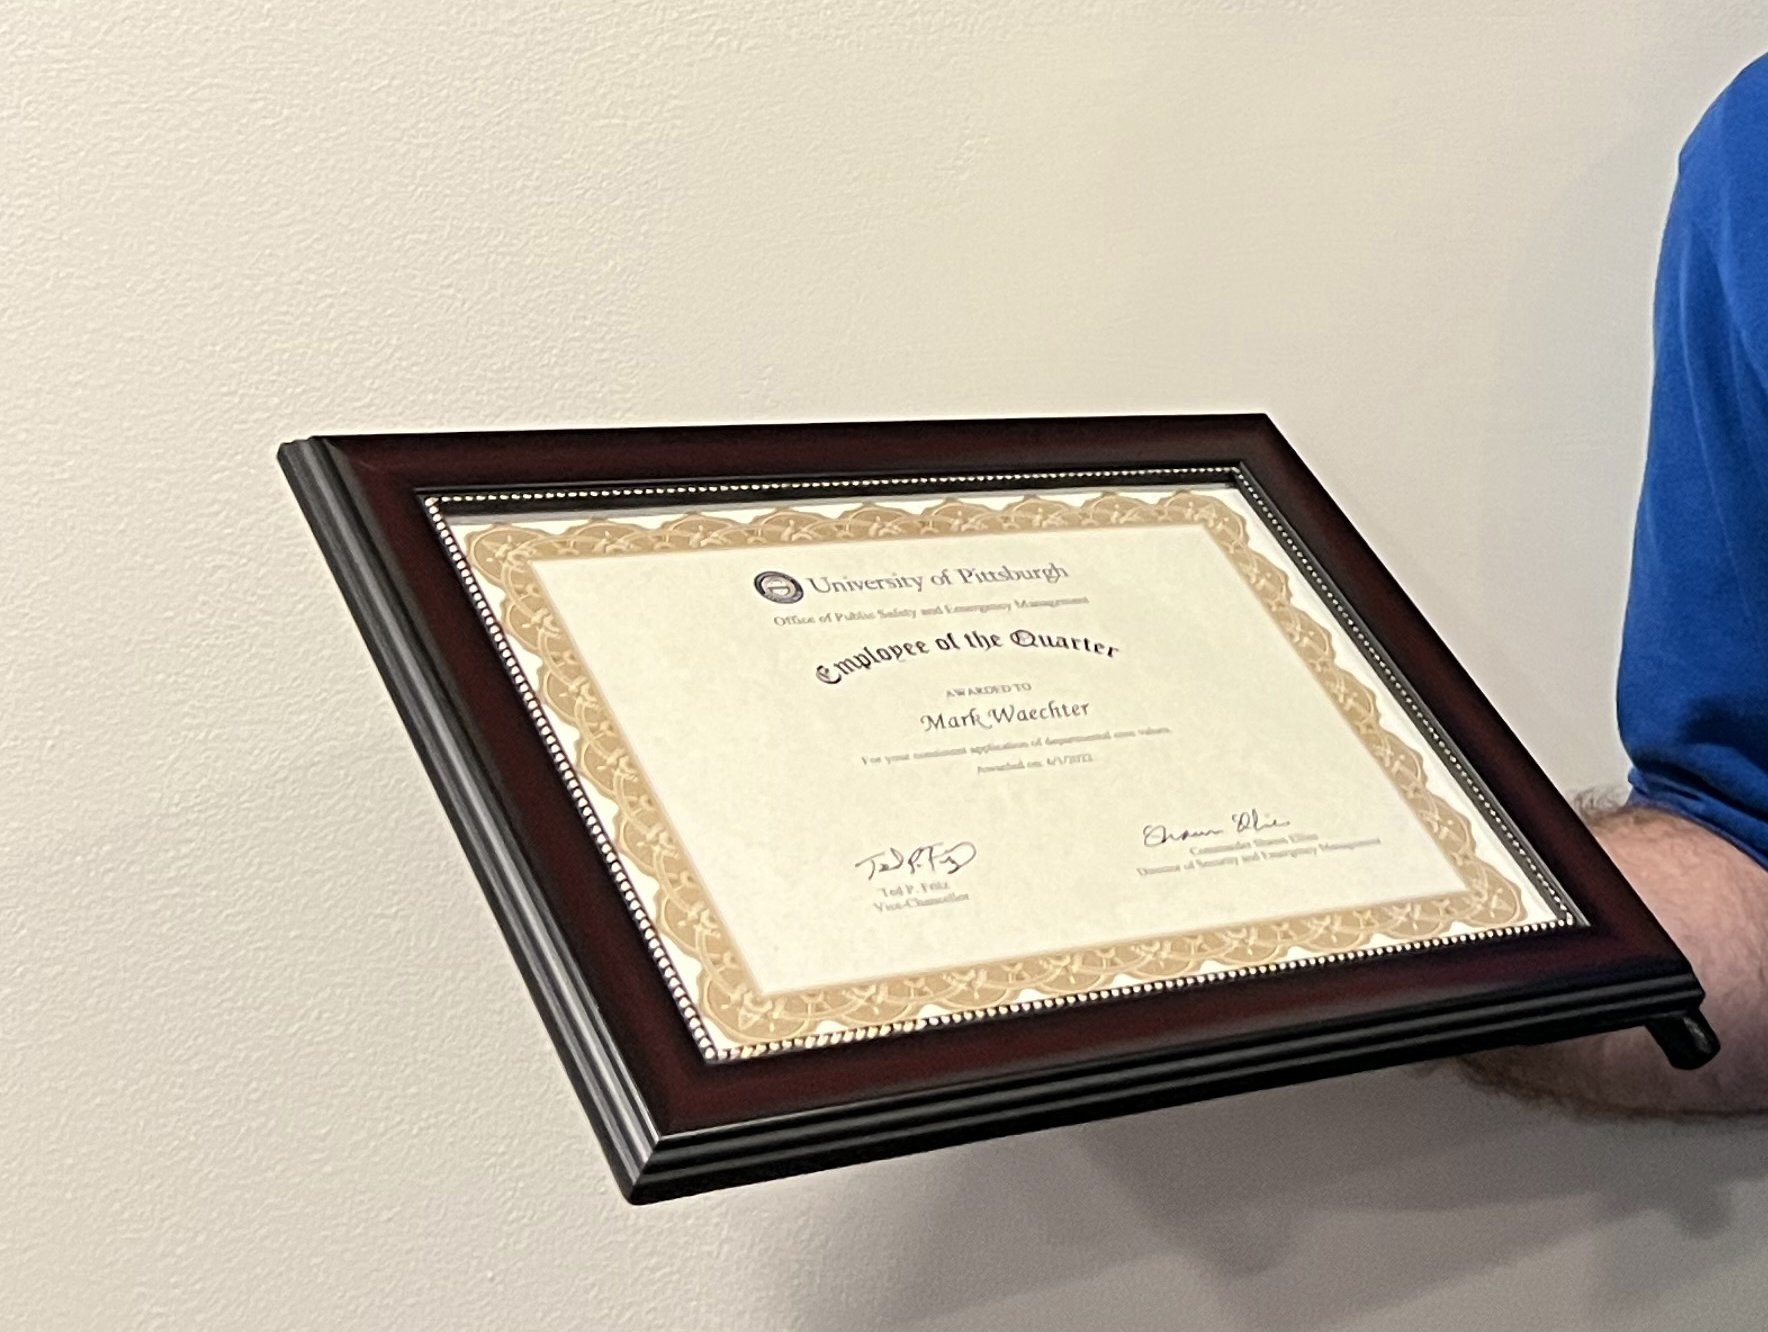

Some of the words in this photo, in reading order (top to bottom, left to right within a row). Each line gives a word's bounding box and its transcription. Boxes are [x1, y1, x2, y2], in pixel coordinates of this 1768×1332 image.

[806, 571, 923, 596] University
[930, 572, 951, 587] of
[957, 562, 1069, 585] Pittsburgh
[815, 639, 928, 684] Employee
[935, 633, 961, 651] of
[964, 630, 1004, 651] the
[1009, 629, 1120, 658] Quarter
[920, 707, 993, 732] Mark
[987, 700, 1090, 724] Waechter
